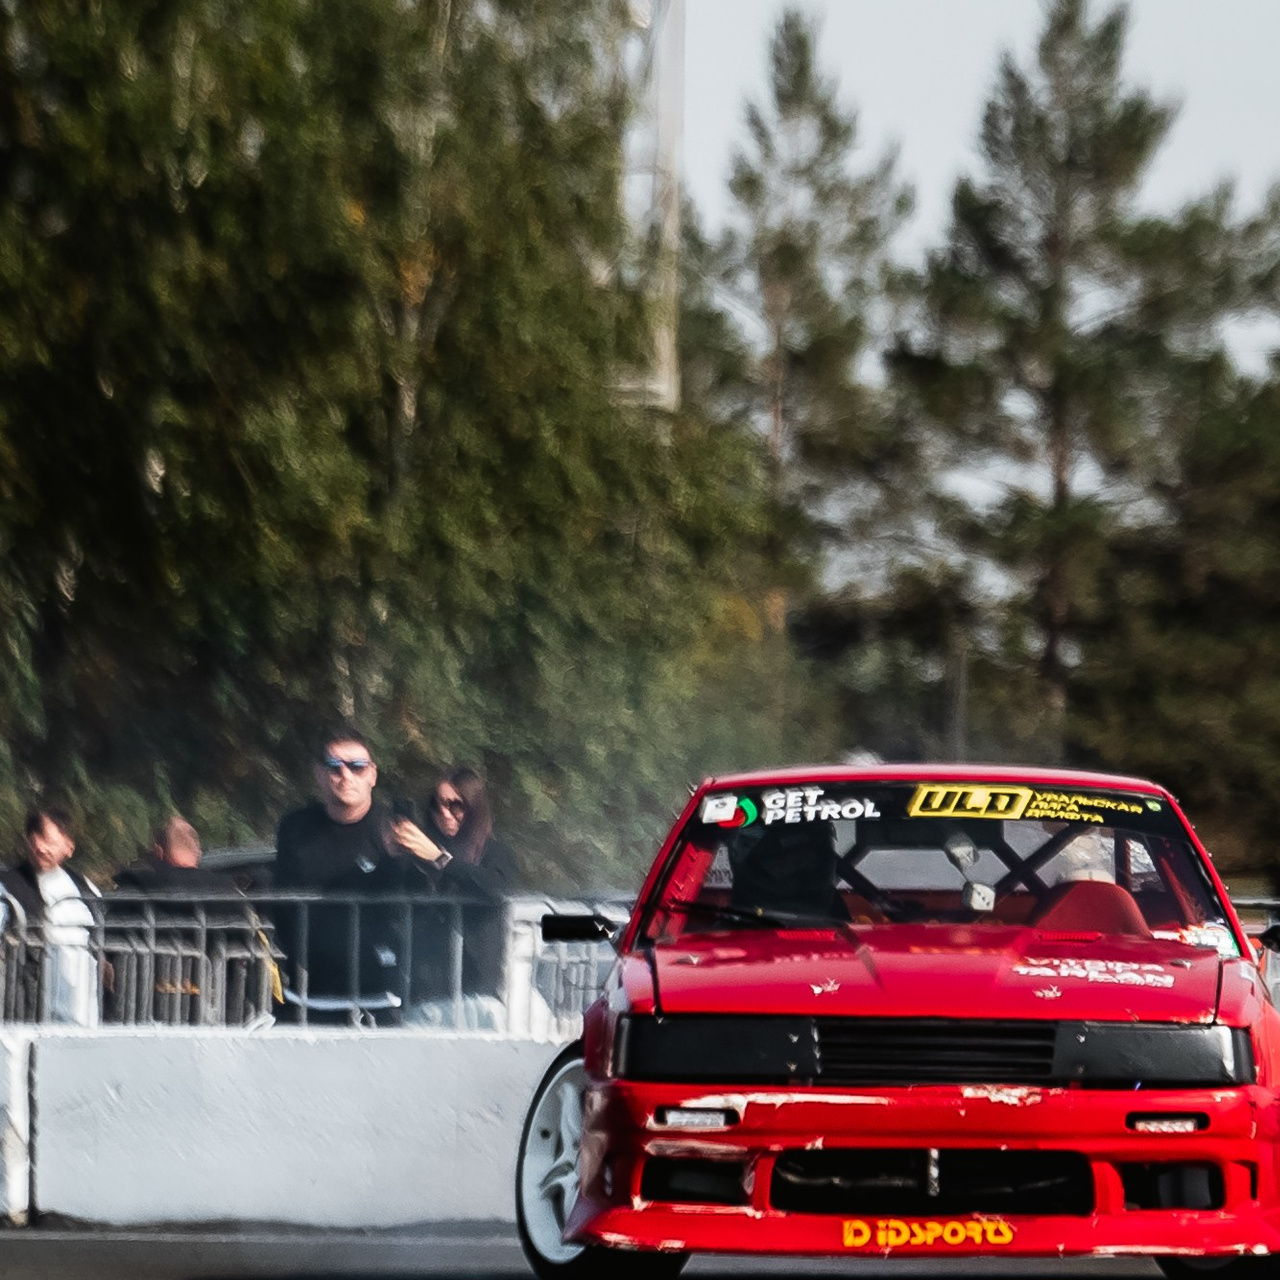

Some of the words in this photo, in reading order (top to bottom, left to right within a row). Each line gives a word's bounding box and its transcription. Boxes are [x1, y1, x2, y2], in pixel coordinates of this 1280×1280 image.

[762, 786, 824, 809] GET
[915, 787, 1026, 815] ULD
[1034, 791, 1143, 814] УРАЛЬСКАЯ
[763, 799, 881, 825] PETROL
[1025, 809, 1104, 823] ДРИФТА
